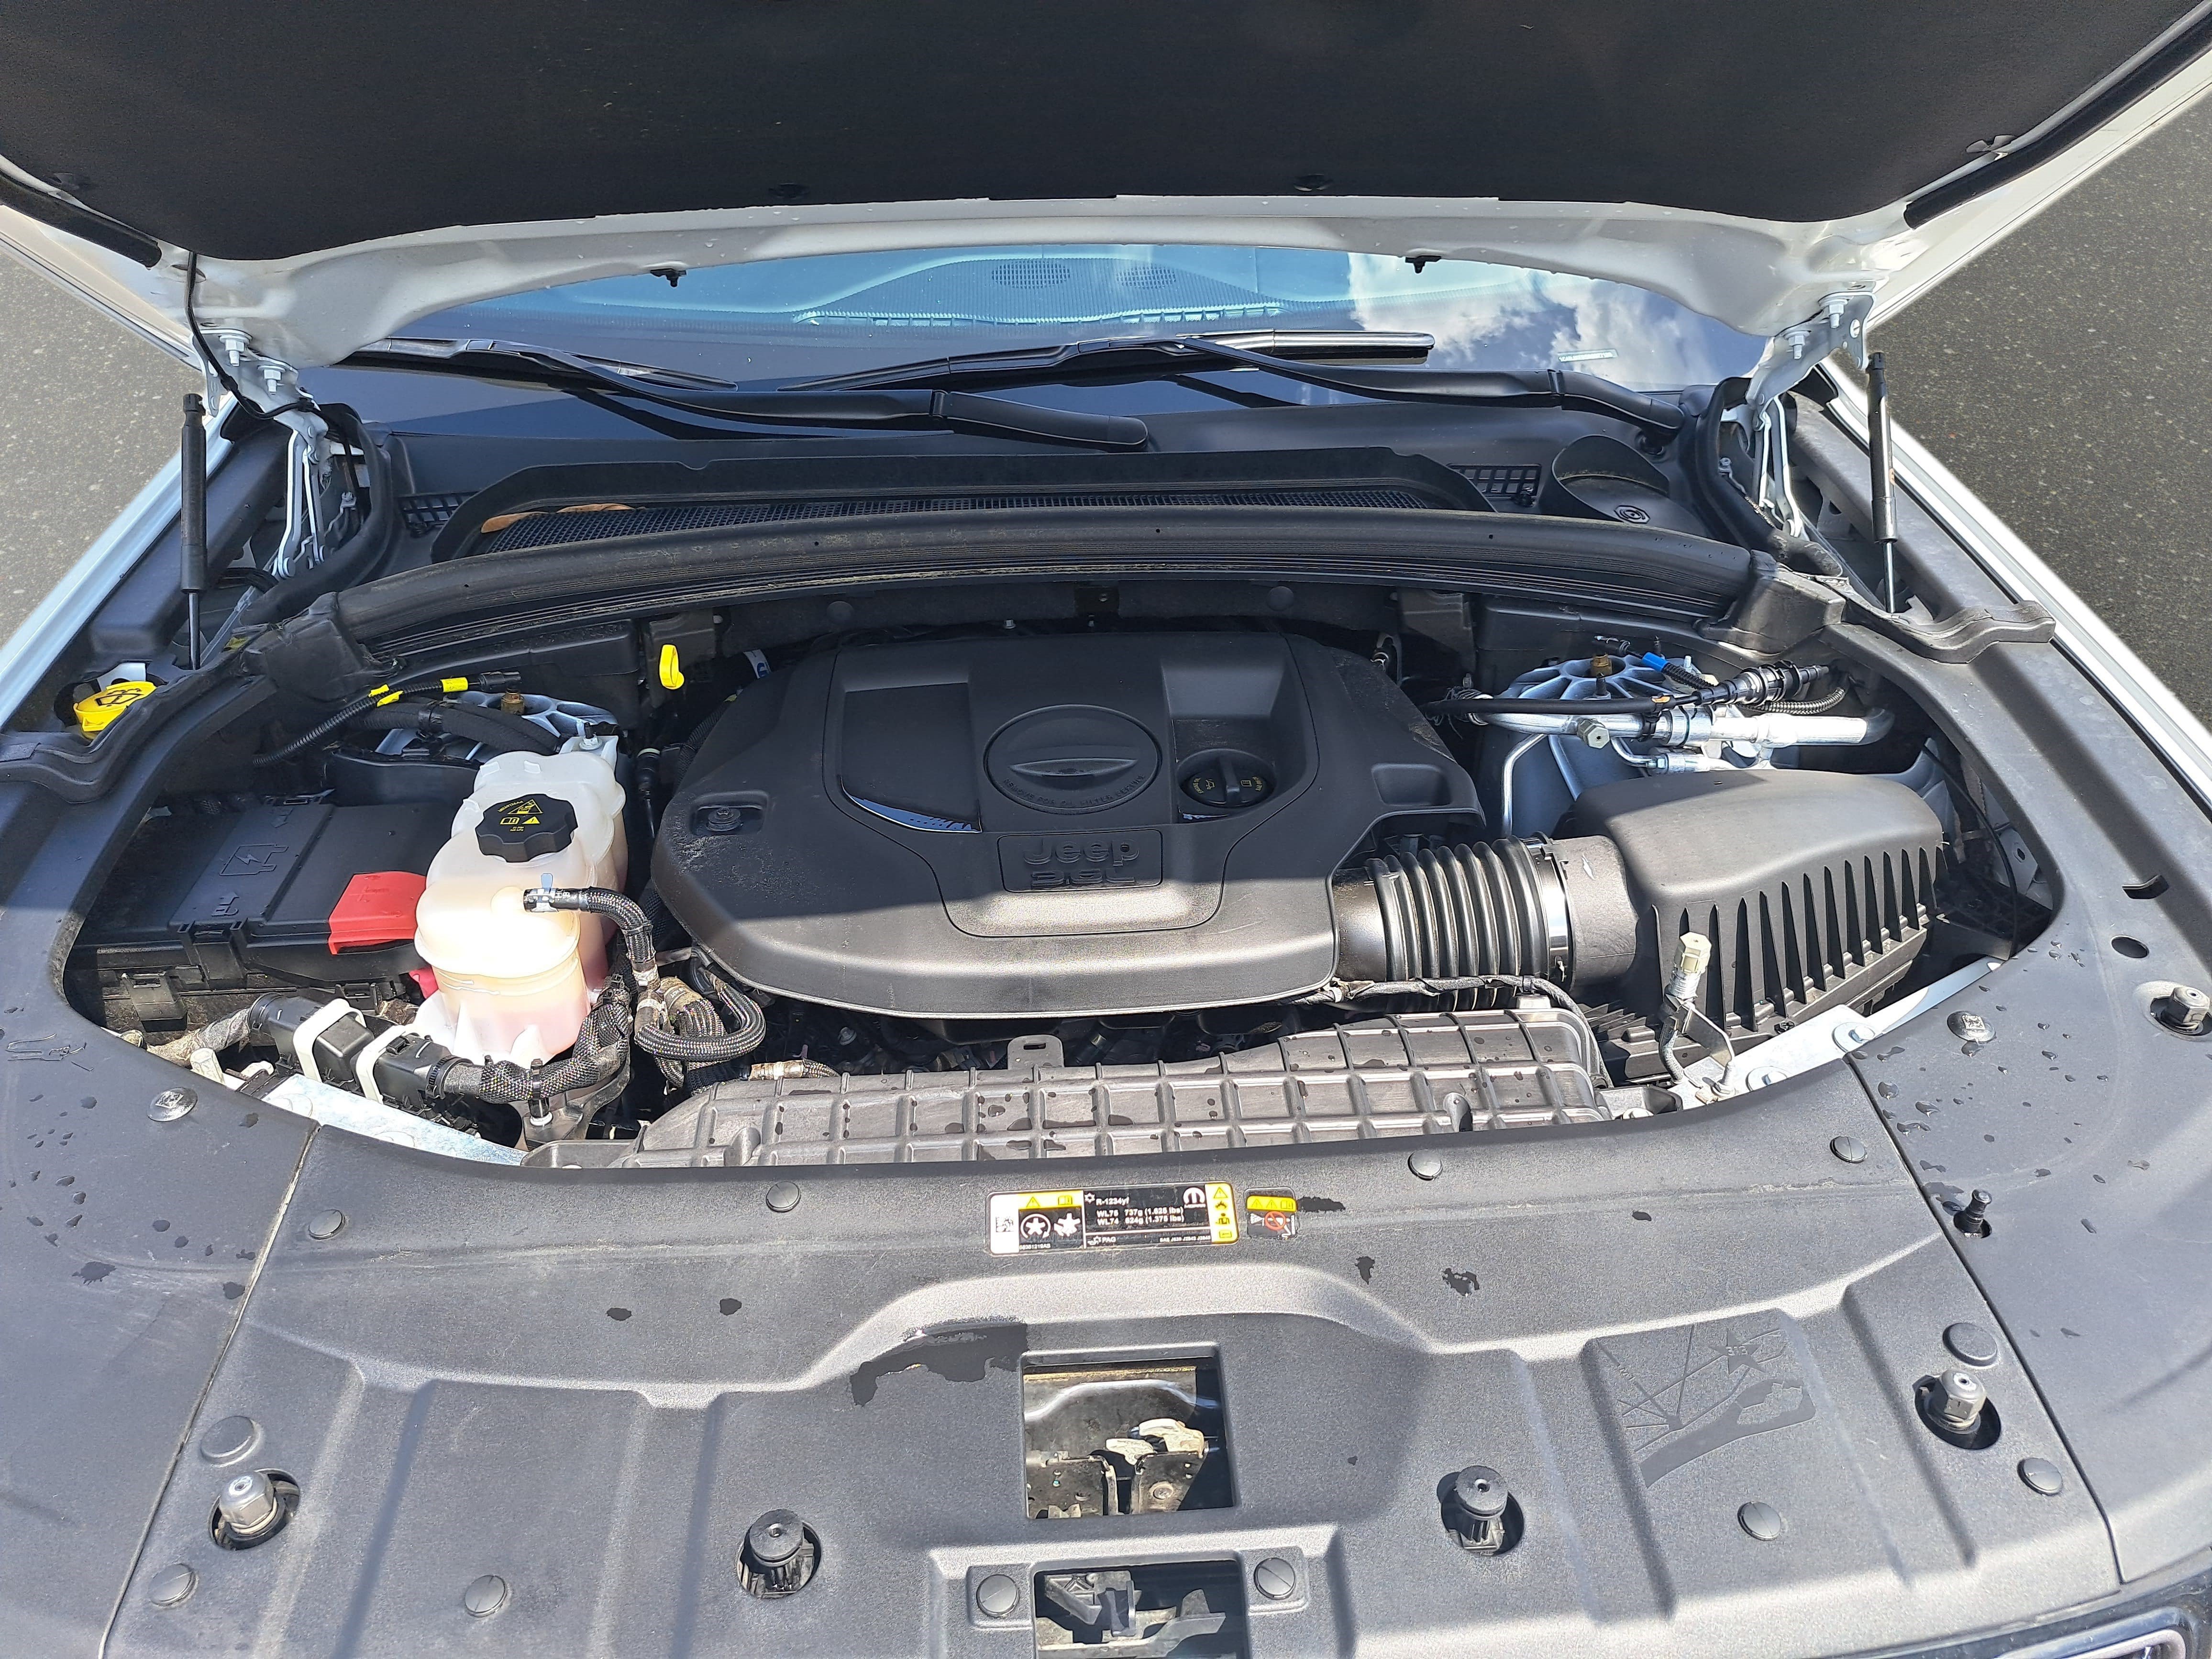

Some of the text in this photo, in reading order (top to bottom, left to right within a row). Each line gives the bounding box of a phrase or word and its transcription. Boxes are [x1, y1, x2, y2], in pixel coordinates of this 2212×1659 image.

[1023, 838, 1139, 866] Jeep
[1031, 868, 1136, 887] 3.6L
[1095, 1196, 1129, 1206] R-1234yf
[1124, 1208, 1143, 1217] 737g
[1169, 1206, 1184, 1215] lbs)
[1097, 1217, 1119, 1226] WL74
[1169, 1215, 1185, 1223] lbs)
